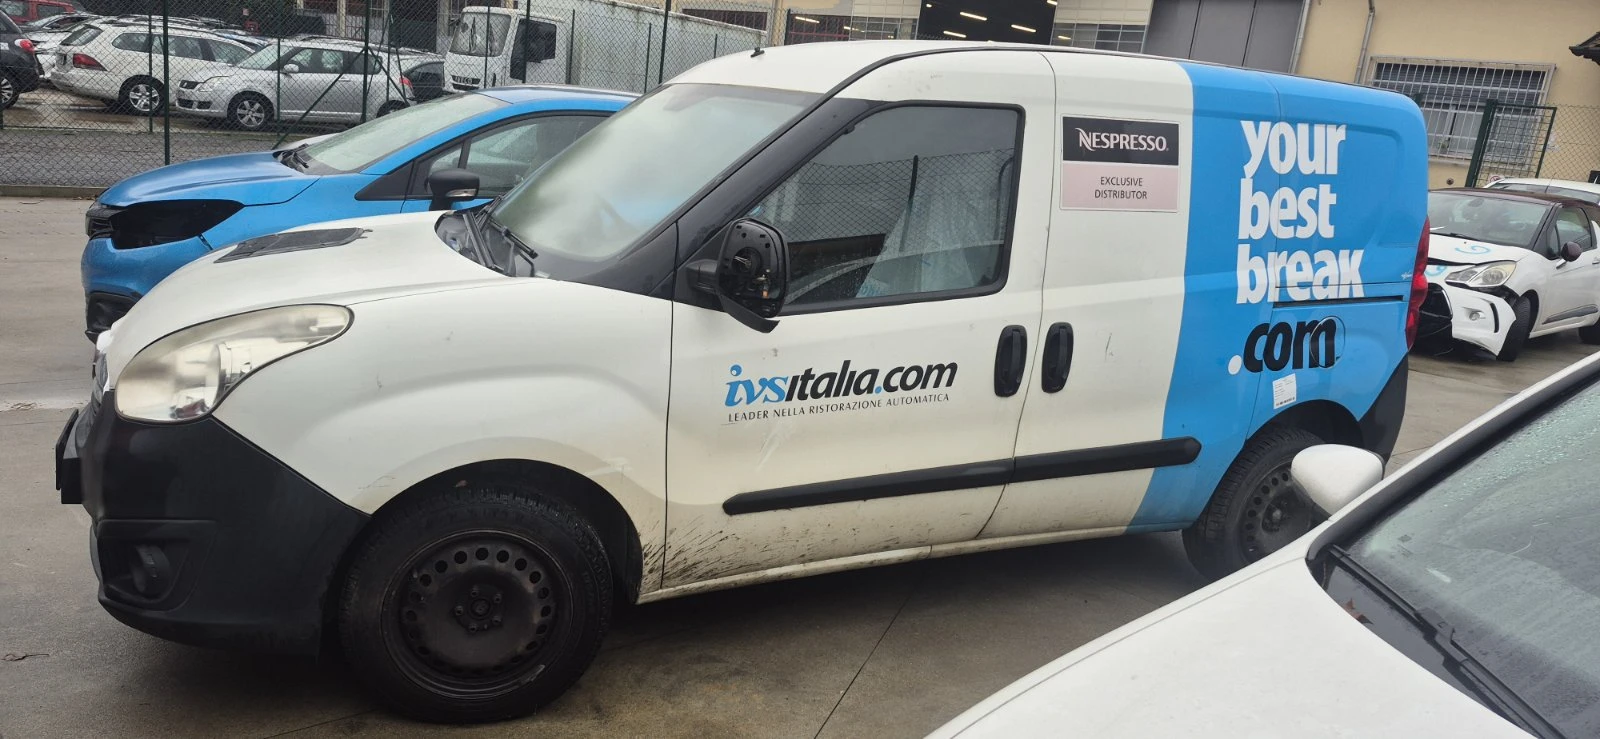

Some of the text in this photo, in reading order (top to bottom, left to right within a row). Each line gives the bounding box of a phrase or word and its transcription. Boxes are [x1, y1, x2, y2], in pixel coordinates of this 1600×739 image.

[1075, 128, 1168, 151] NESPRESSO
[1240, 120, 1347, 179] your
[1094, 189, 1148, 199] DISTRIBUTOR
[1100, 176, 1143, 187] EXCLUSIVE
[1238, 178, 1337, 240] best
[1236, 243, 1365, 304] break
[1228, 316, 1337, 375] .com
[724, 359, 958, 407] ivsitalia.com
[728, 393, 950, 423] LEADER NELLA RISTORAZIONE AUTOMATICA
